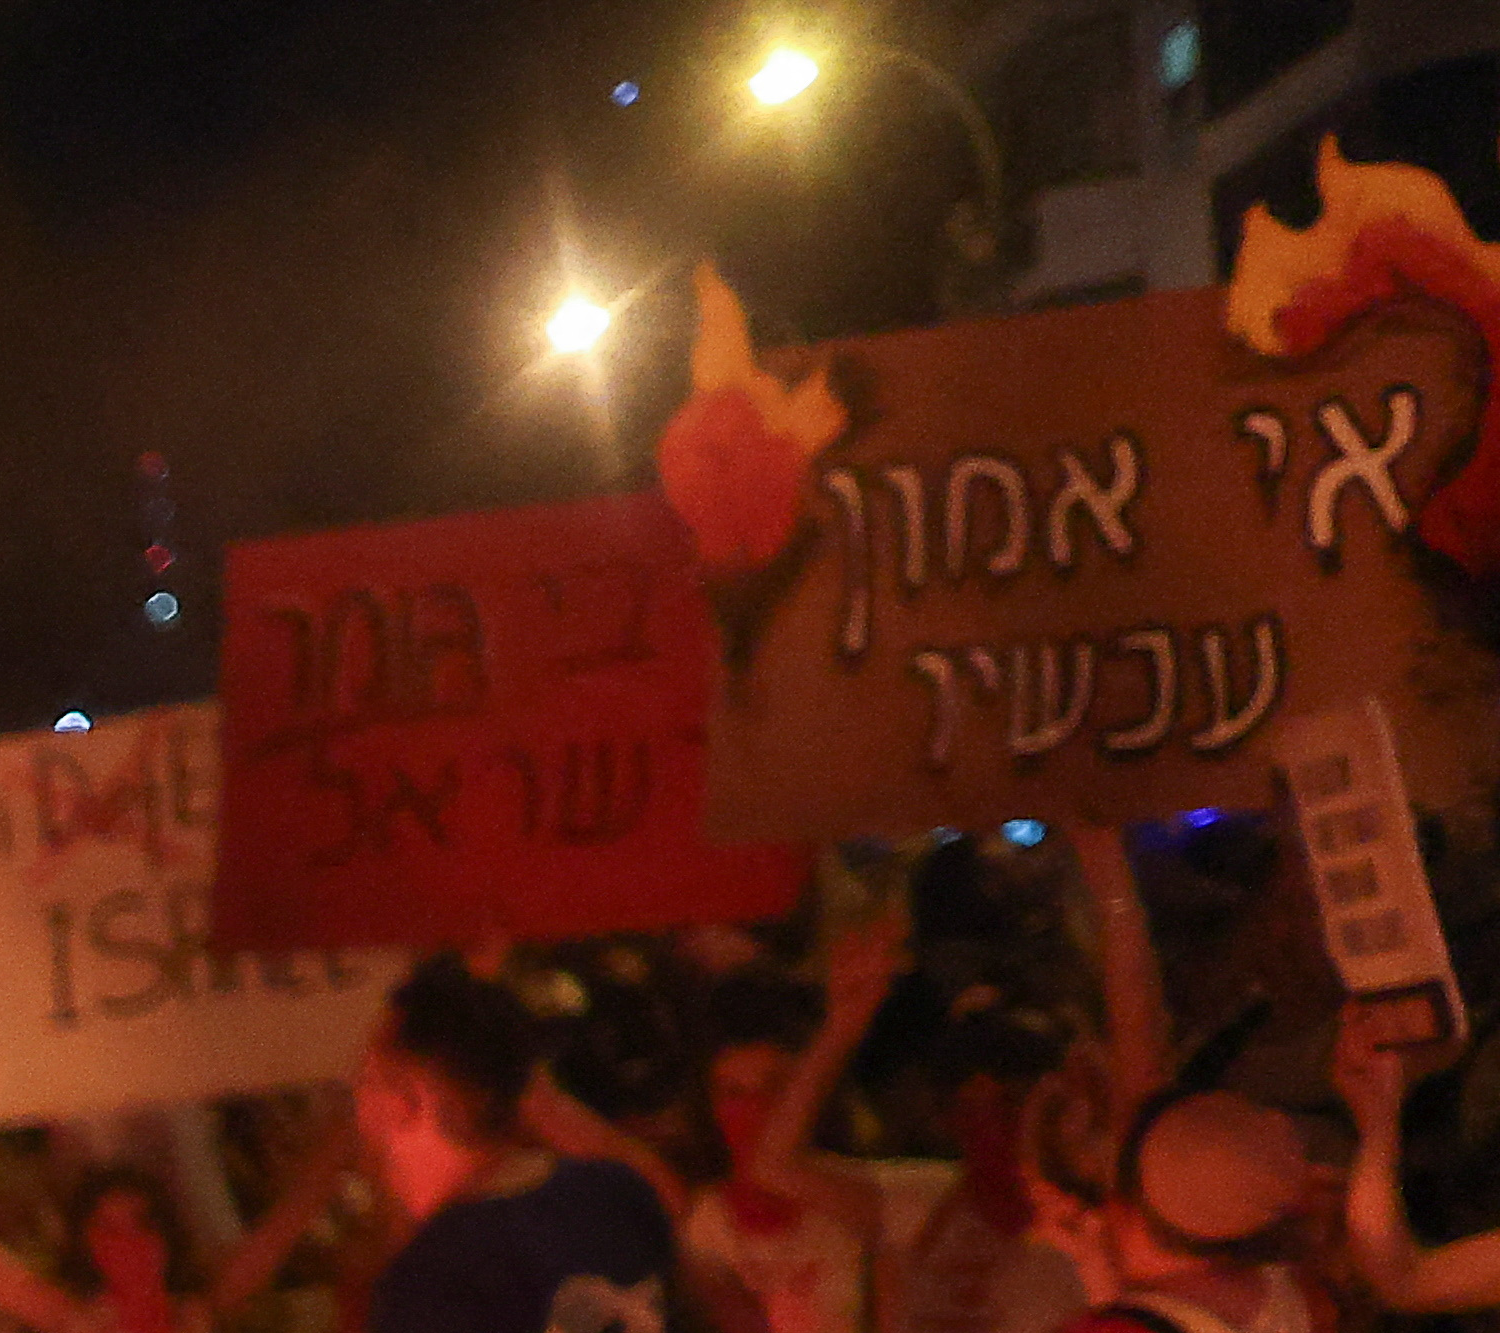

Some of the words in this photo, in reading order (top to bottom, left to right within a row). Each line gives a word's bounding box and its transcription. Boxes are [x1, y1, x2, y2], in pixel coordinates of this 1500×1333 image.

[826, 435, 1141, 656] אמון
[1240, 387, 1424, 558] אי
[915, 618, 1281, 764] עכשיו
